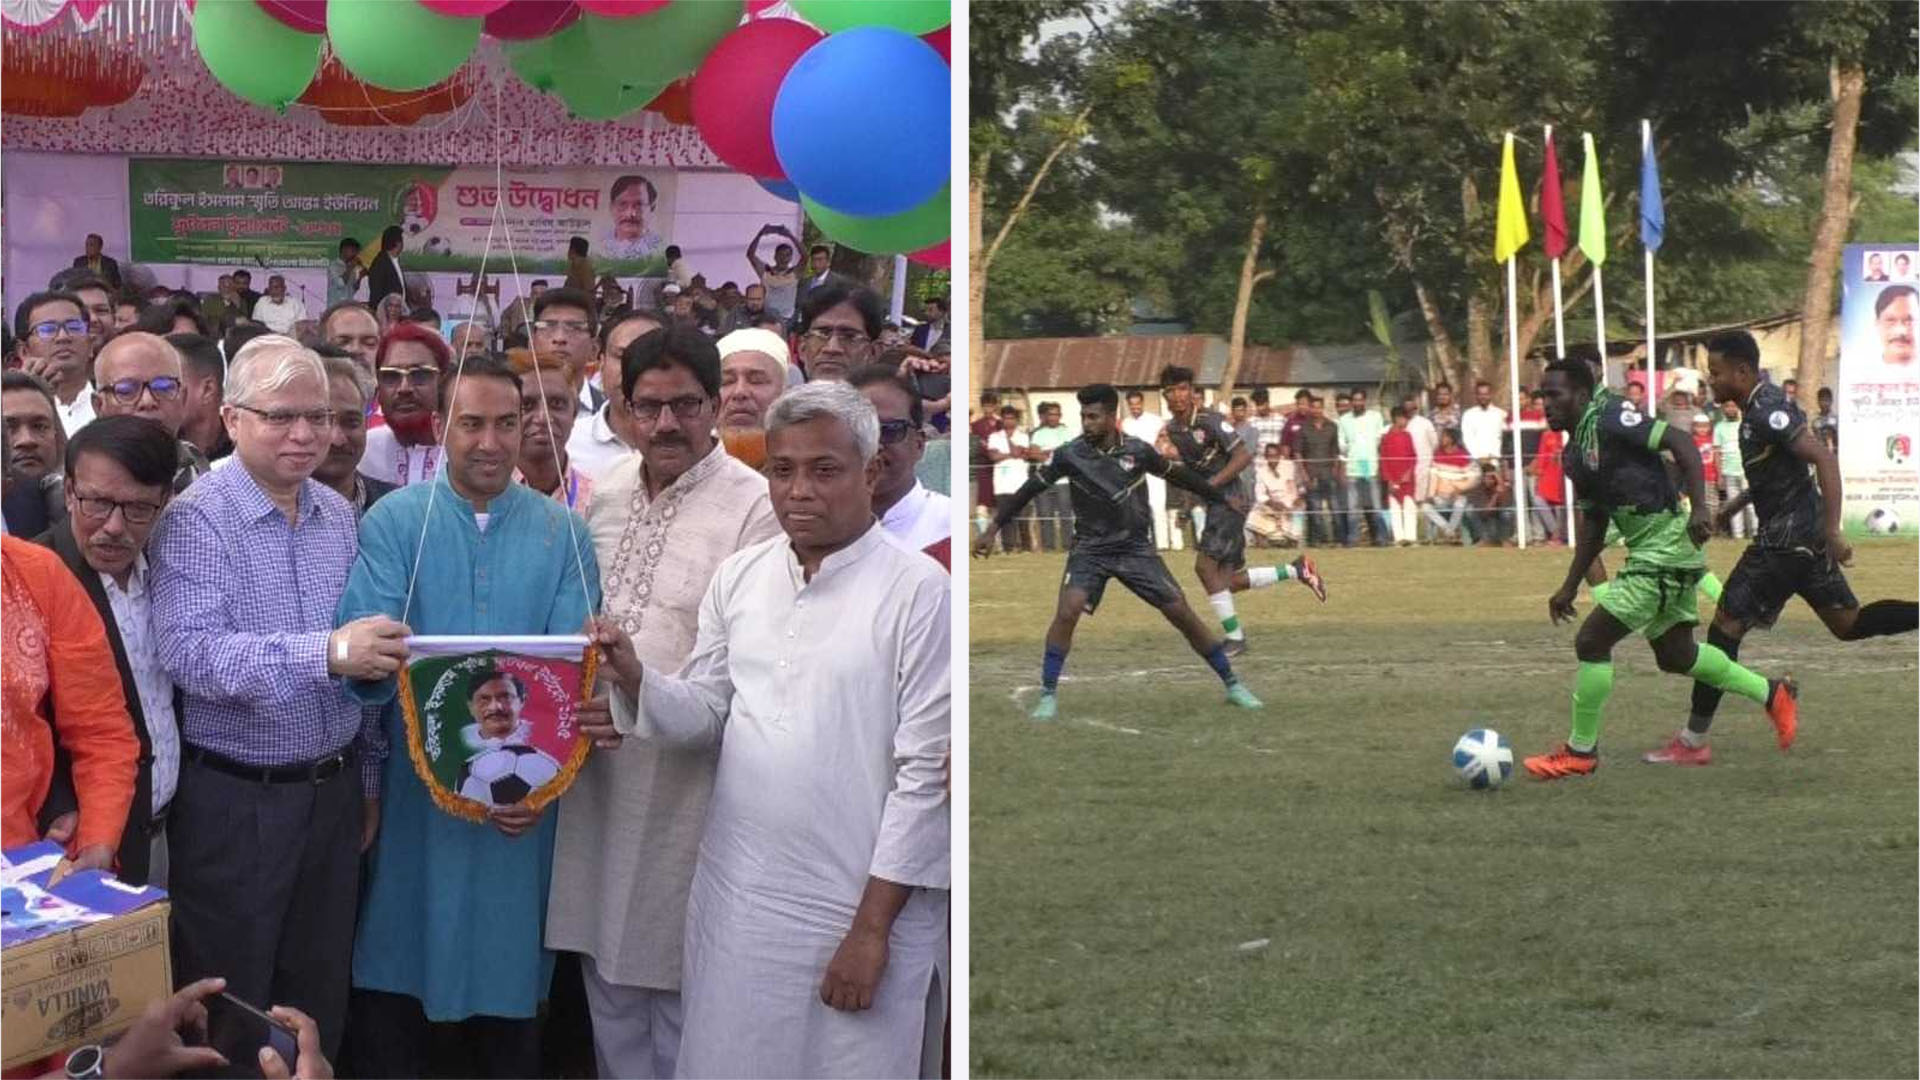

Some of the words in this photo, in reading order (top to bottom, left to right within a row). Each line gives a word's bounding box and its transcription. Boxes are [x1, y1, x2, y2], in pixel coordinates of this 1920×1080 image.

[143, 186, 195, 211] তরিকুল
[198, 191, 245, 208] ইসলাম
[322, 192, 379, 212] ইউনিয়ন
[456, 185, 500, 208] শুভ
[507, 180, 601, 213] উদ্বোধন
[37, 978, 111, 1018] VANILLA
